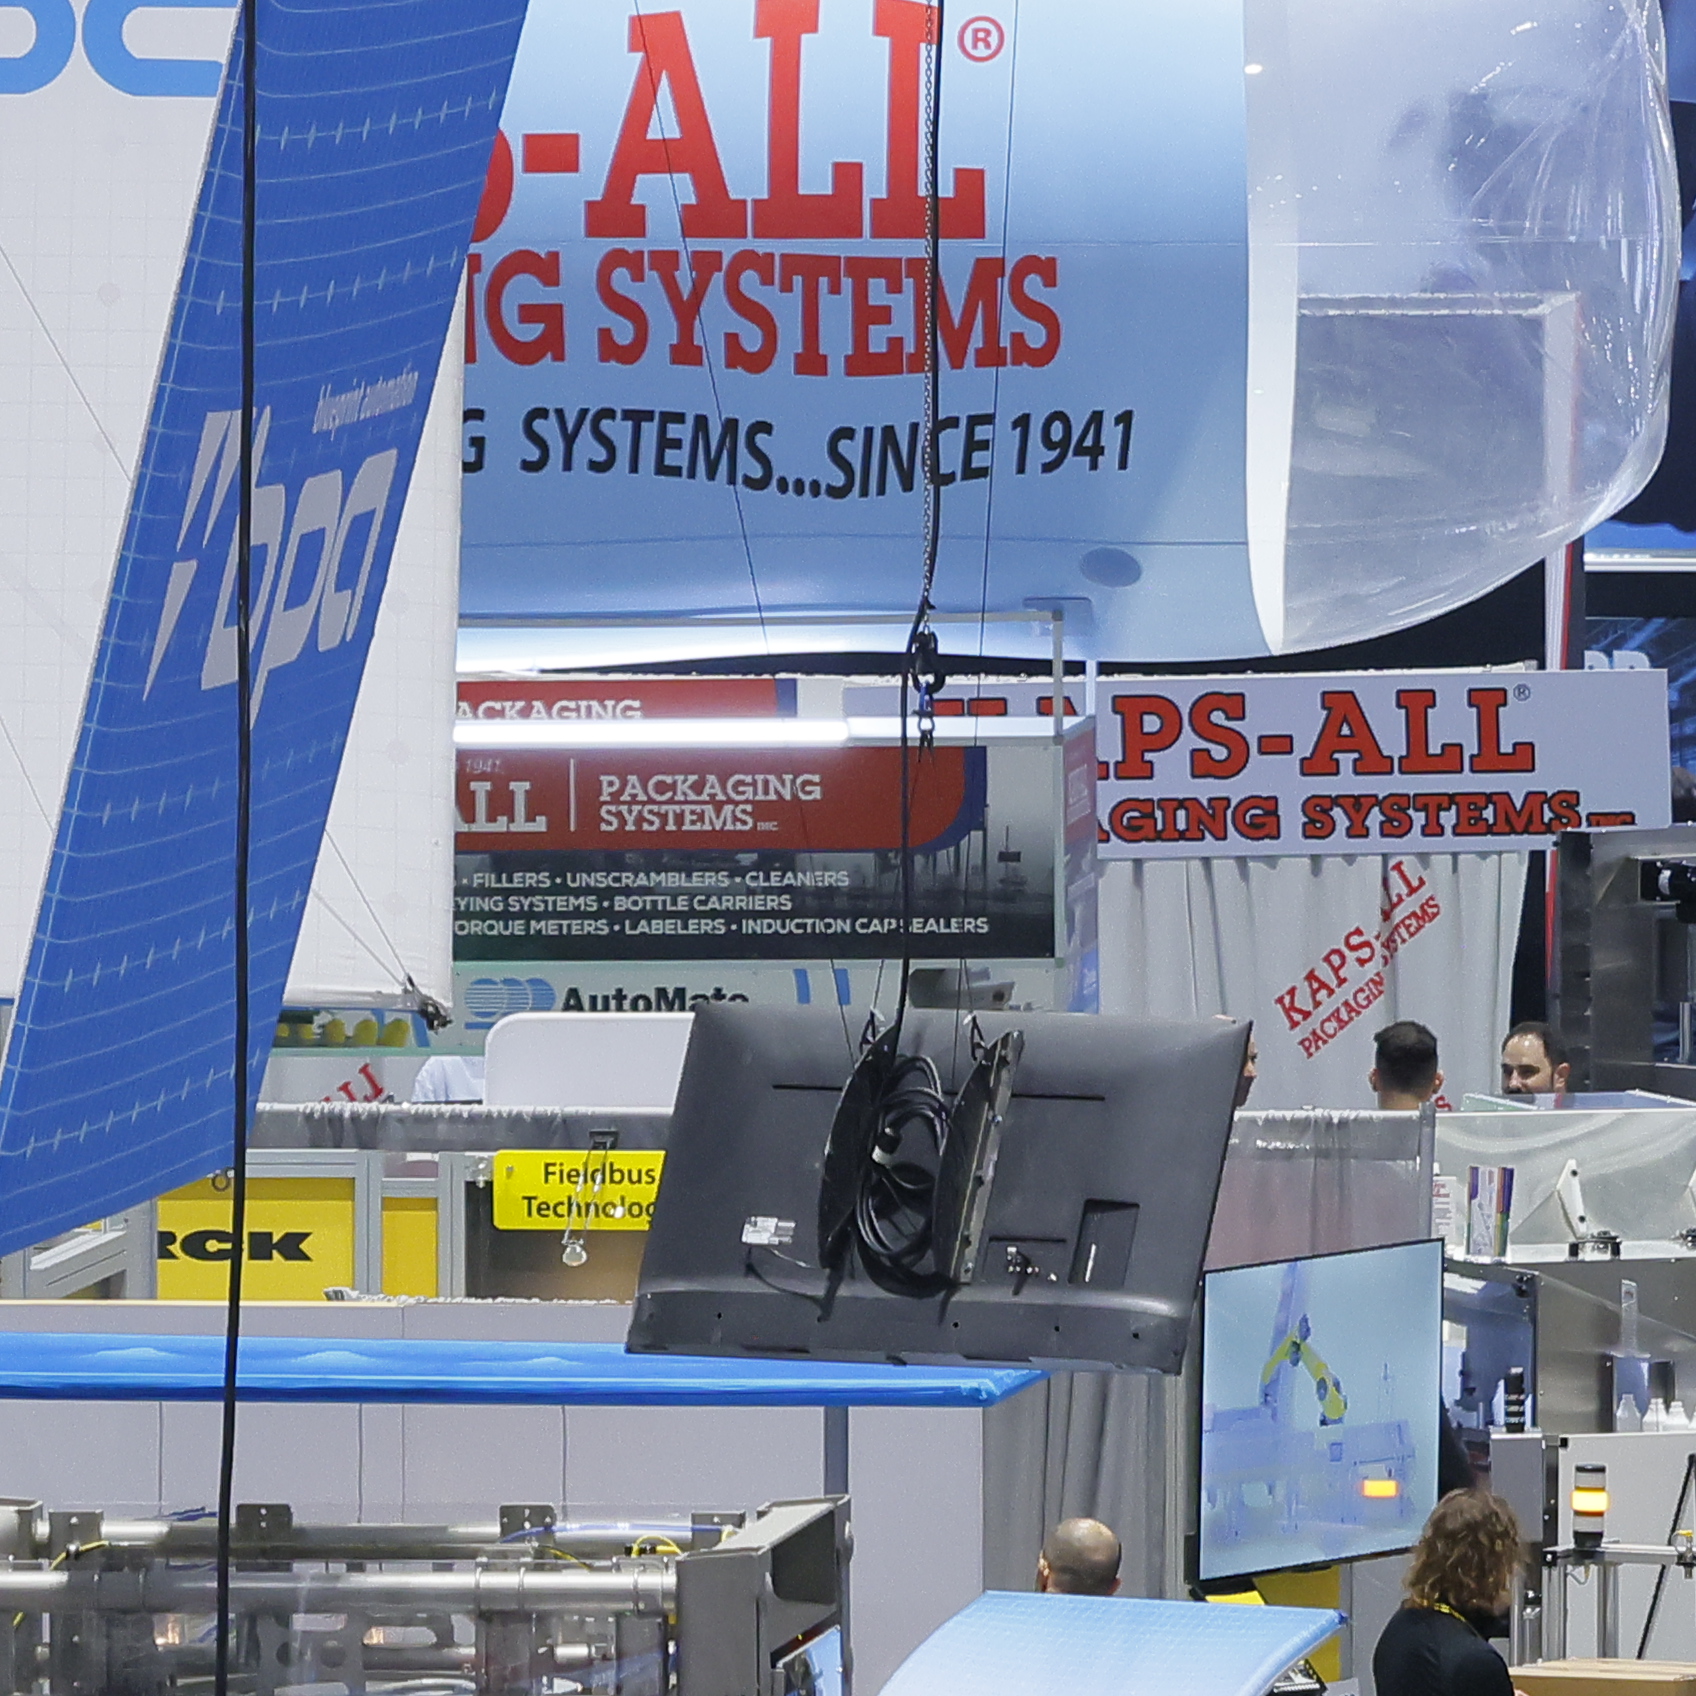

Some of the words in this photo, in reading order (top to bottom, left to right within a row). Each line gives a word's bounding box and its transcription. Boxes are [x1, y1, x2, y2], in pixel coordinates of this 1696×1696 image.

[597, 247, 1061, 377] SYSTEMS
[1010, 408, 1135, 477] 1941
[1097, 687, 1536, 781] PS-ALL
[599, 774, 822, 802] PACKAGING
[599, 804, 754, 832] SYSTEMS
[1300, 790, 1581, 838] SYSTEMS
[473, 871, 551, 888] FILLERS
[567, 871, 731, 888] UNSCRAMBLERS
[746, 870, 849, 887] CLEANERS
[508, 895, 598, 912] SYSTEMS
[614, 895, 691, 911] BOTTLE
[693, 894, 792, 911] CARRIERS
[455, 919, 525, 936] ORQUE
[530, 919, 610, 935] METERS
[624, 918, 726, 935] LABELERS
[742, 917, 852, 935] INDUCTION
[900, 917, 990, 934] EALERS
[1297, 971, 1386, 1060] PACKAGIN
[543, 1161, 657, 1185] Fieldbus
